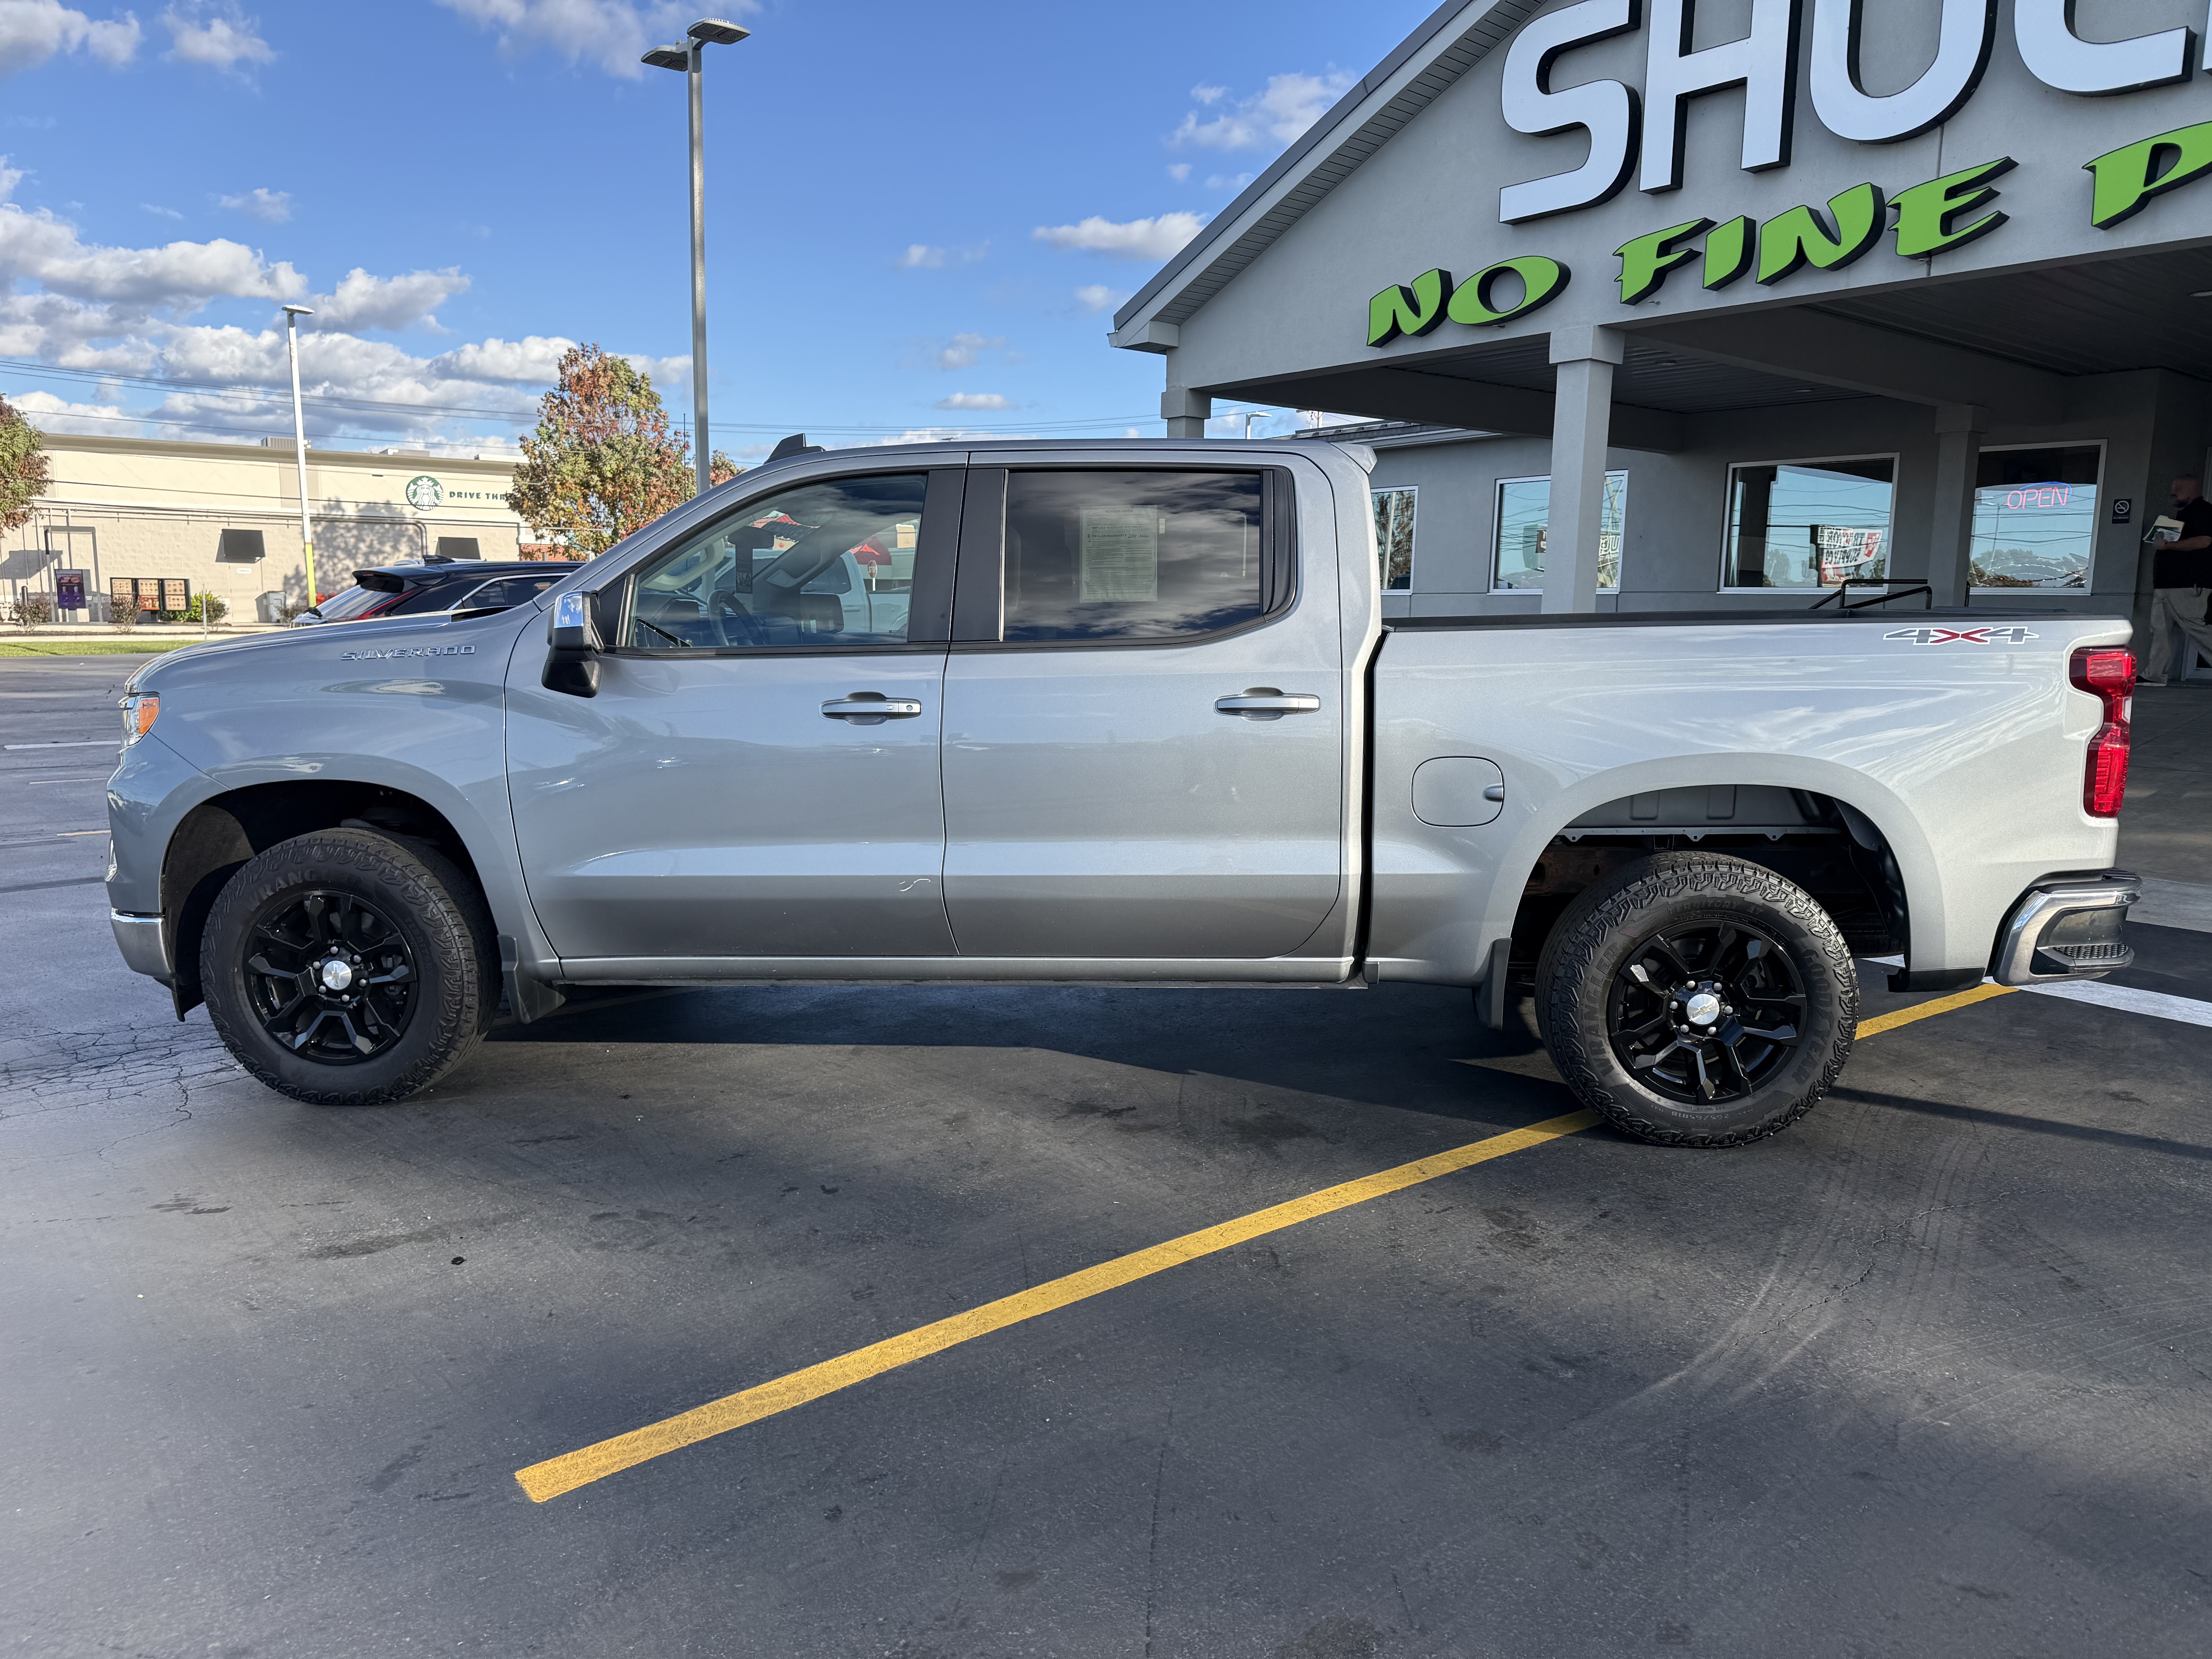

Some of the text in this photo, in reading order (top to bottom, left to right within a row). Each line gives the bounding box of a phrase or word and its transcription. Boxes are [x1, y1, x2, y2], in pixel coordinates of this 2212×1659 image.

[1367, 255, 1571, 348] NO
[1612, 156, 2019, 306] FINE
[449, 491, 481, 499] DRIVE
[2007, 486, 2069, 510] OPEN
[341, 645, 475, 660] SILVERADO
[1585, 943, 1623, 1077] WRANGLER
[1671, 1111, 1730, 1120] 265/65R18
